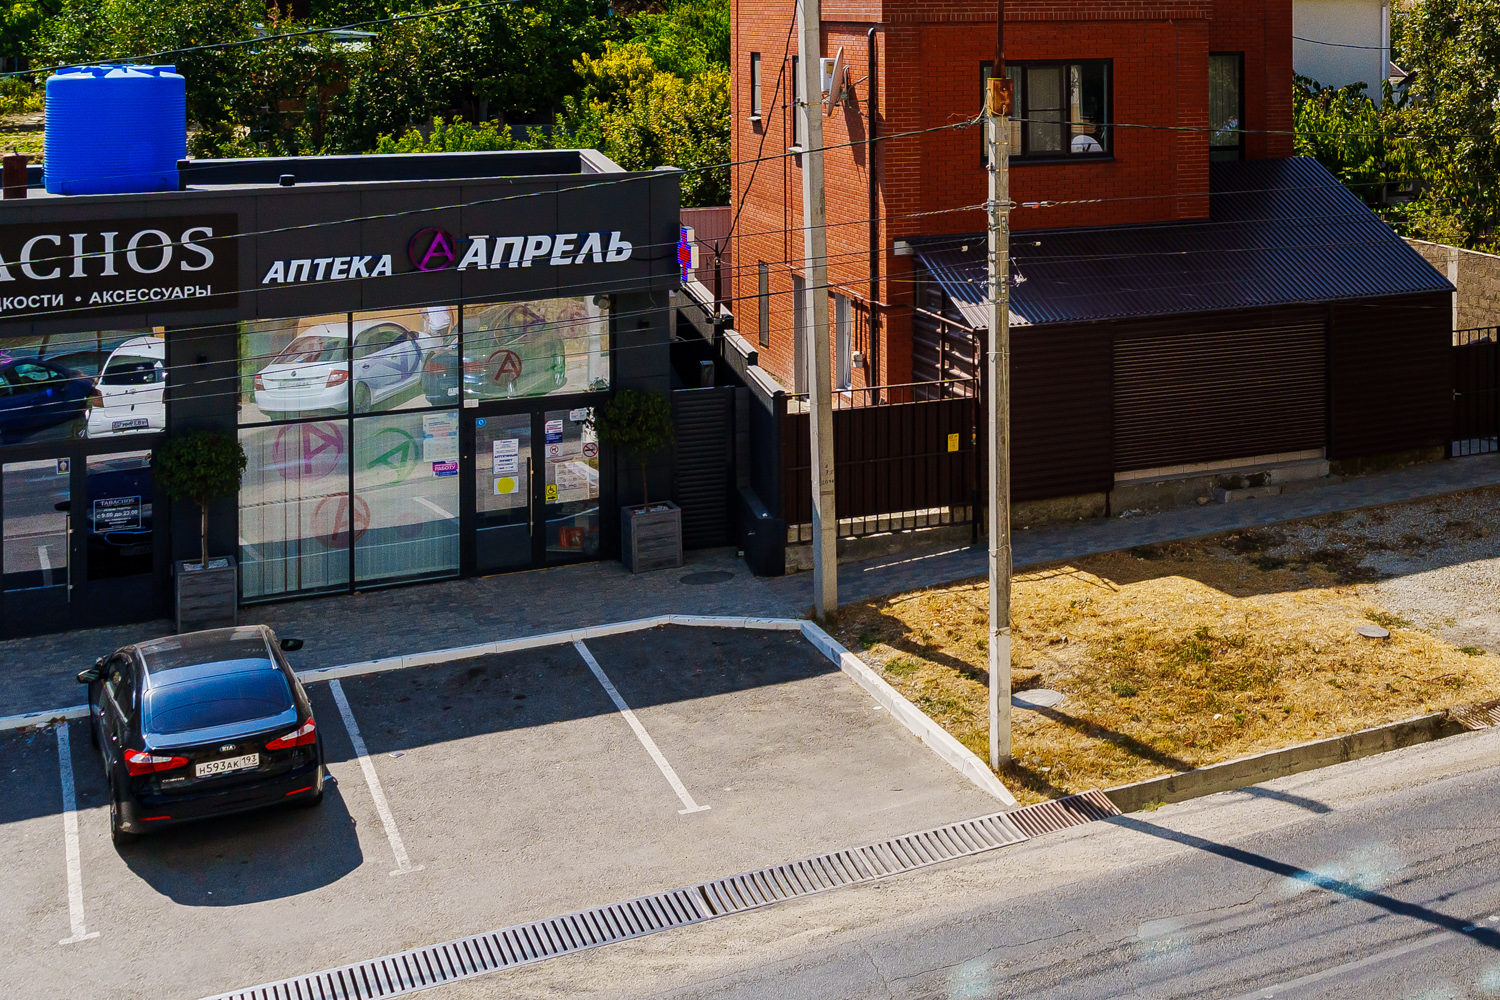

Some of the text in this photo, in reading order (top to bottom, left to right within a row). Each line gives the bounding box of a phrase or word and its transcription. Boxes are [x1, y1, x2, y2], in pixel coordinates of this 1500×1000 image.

[262, 254, 393, 284] АПТЕКА
[457, 231, 633, 271] АПРЕЛЬ
[89, 284, 212, 304] АКСЕССУАРЫ
[199, 760, 240, 775] Н593АК
[241, 755, 257, 764] 193
